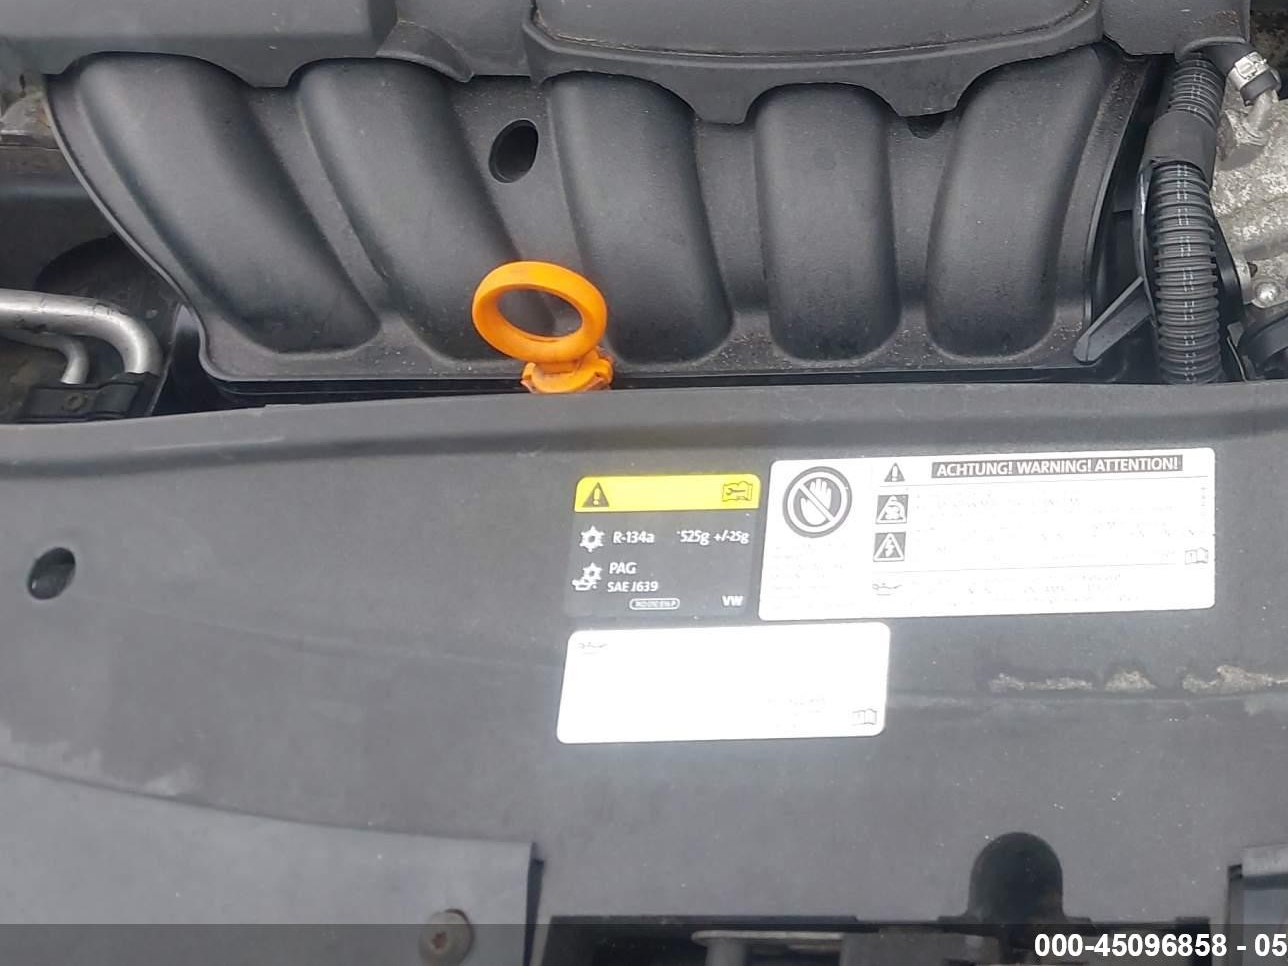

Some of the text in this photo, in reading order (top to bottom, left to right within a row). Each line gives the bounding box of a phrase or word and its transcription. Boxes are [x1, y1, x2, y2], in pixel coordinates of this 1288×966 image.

[936, 456, 1179, 478] ACHTUNG! WARNING! ATTENTION!
[612, 530, 656, 544] R-134a
[608, 561, 637, 575] PAG
[607, 581, 659, 593] SAE J639
[721, 595, 744, 607] VW
